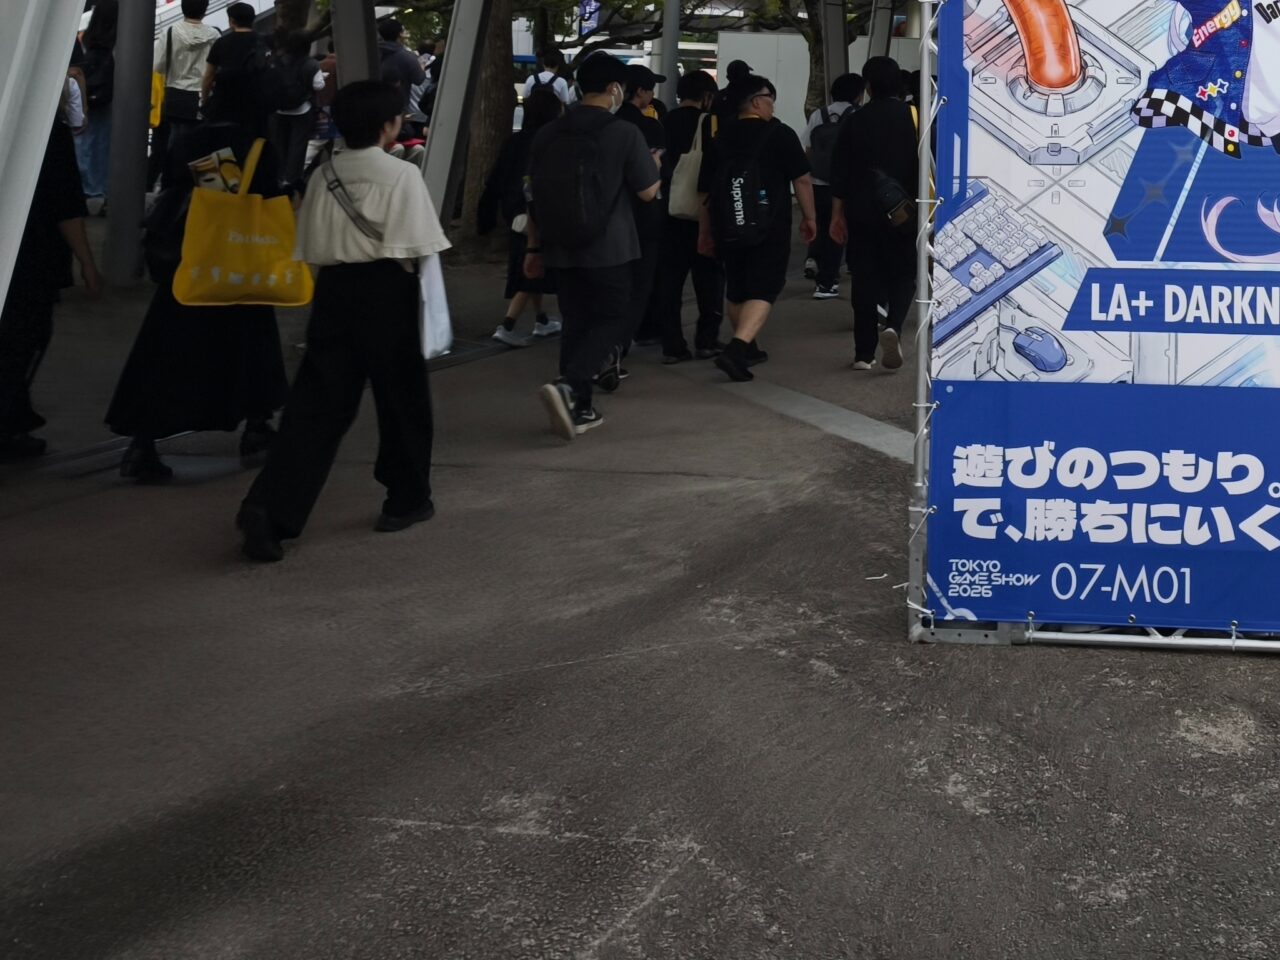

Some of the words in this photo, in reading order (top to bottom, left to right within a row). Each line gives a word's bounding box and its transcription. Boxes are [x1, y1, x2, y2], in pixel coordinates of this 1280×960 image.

[730, 177, 745, 226] Supreme
[1091, 283, 1153, 321] LA+
[948, 558, 1001, 573] TOKYO
[948, 571, 990, 585] GAME
[990, 572, 1041, 587] SHOW
[948, 584, 993, 597] 2026
[1051, 562, 1191, 604] 07-M01
